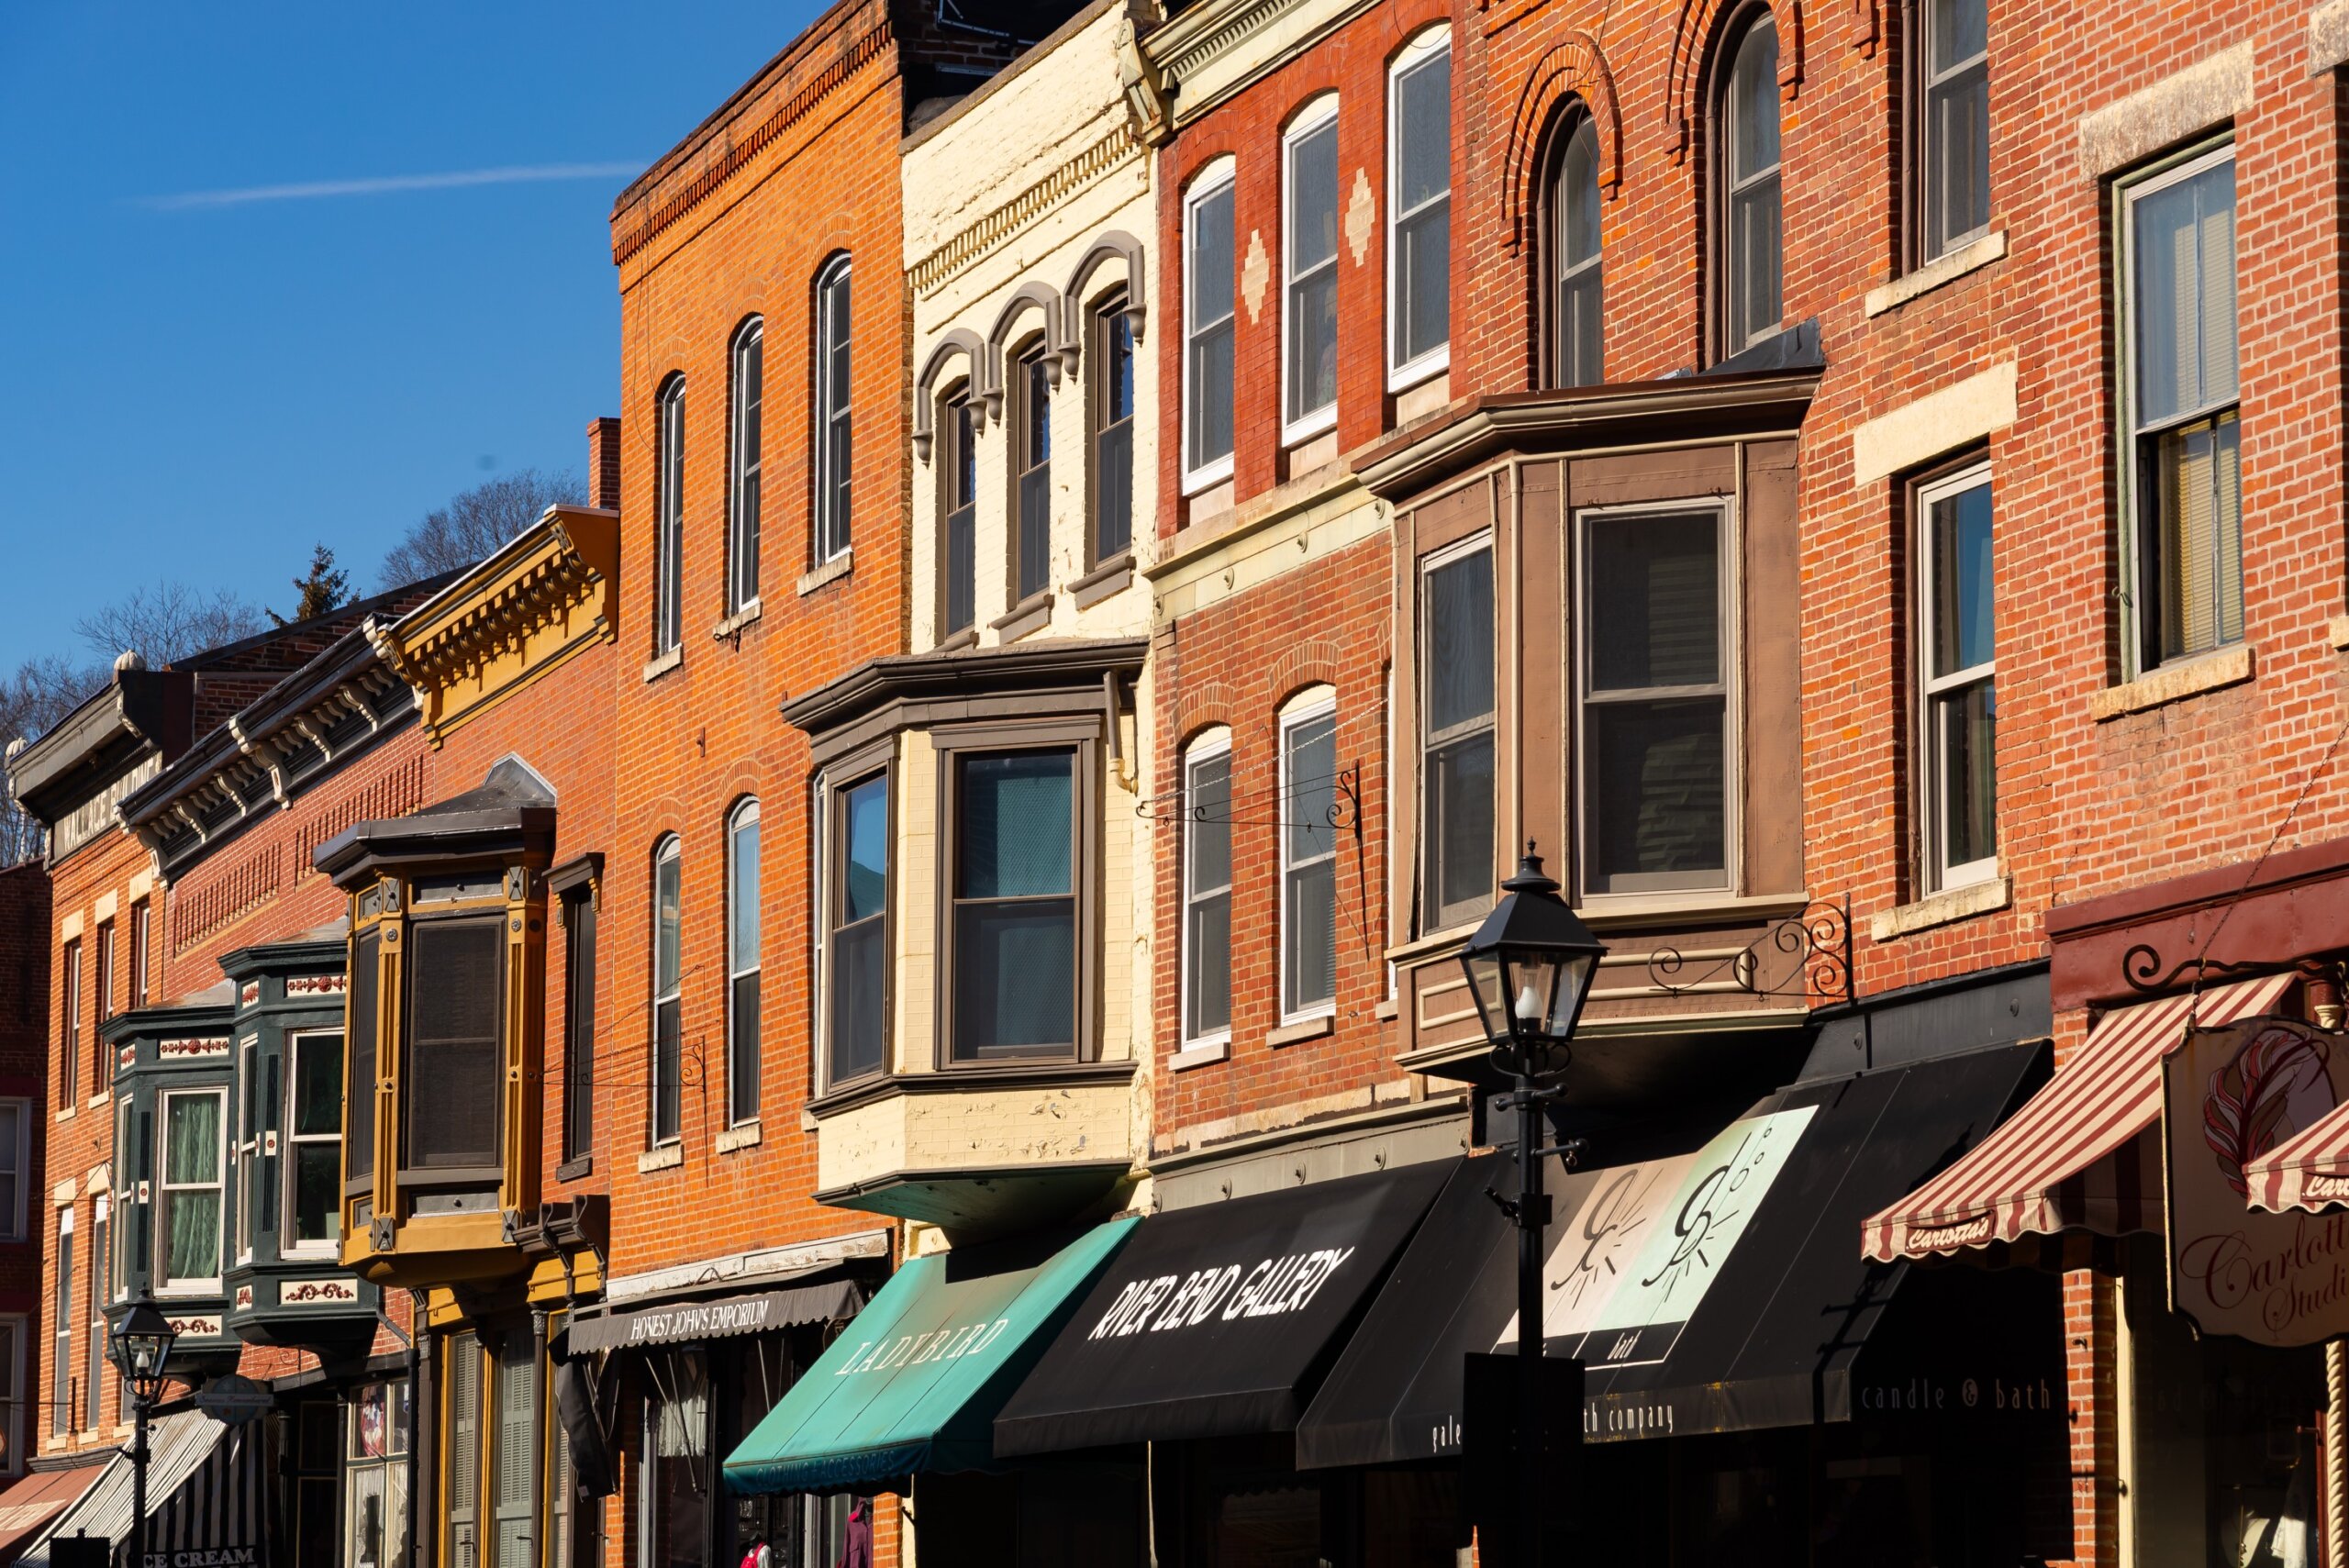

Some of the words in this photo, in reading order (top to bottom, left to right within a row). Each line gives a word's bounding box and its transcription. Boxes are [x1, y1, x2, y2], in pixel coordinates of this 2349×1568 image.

[63, 789, 107, 852] WALLACE
[1908, 1218, 1989, 1249] Carlotta's
[2179, 1215, 2349, 1309] Carlott
[1087, 1275, 1178, 1340] RIVER
[1150, 1263, 1241, 1331] BEND
[1221, 1246, 1355, 1321] GALLERY
[2263, 1262, 2347, 1336] Studi
[630, 1313, 673, 1340] HONEST
[672, 1307, 709, 1335] JOHN'S
[709, 1300, 770, 1329] EMPORIUM
[835, 1318, 1008, 1375] LADYBIRD
[1608, 1330, 1642, 1361] bath
[1861, 1378, 1945, 1410] candle
[1962, 1377, 1980, 1407] &
[1996, 1377, 2052, 1411] bath
[1432, 1414, 1461, 1453] gale
[1609, 1402, 1674, 1433] company
[756, 1462, 808, 1486] CLOTHING
[820, 1450, 895, 1479] ACCESSORIES
[143, 1553, 168, 1568] CE
[174, 1547, 254, 1567] CREAM
